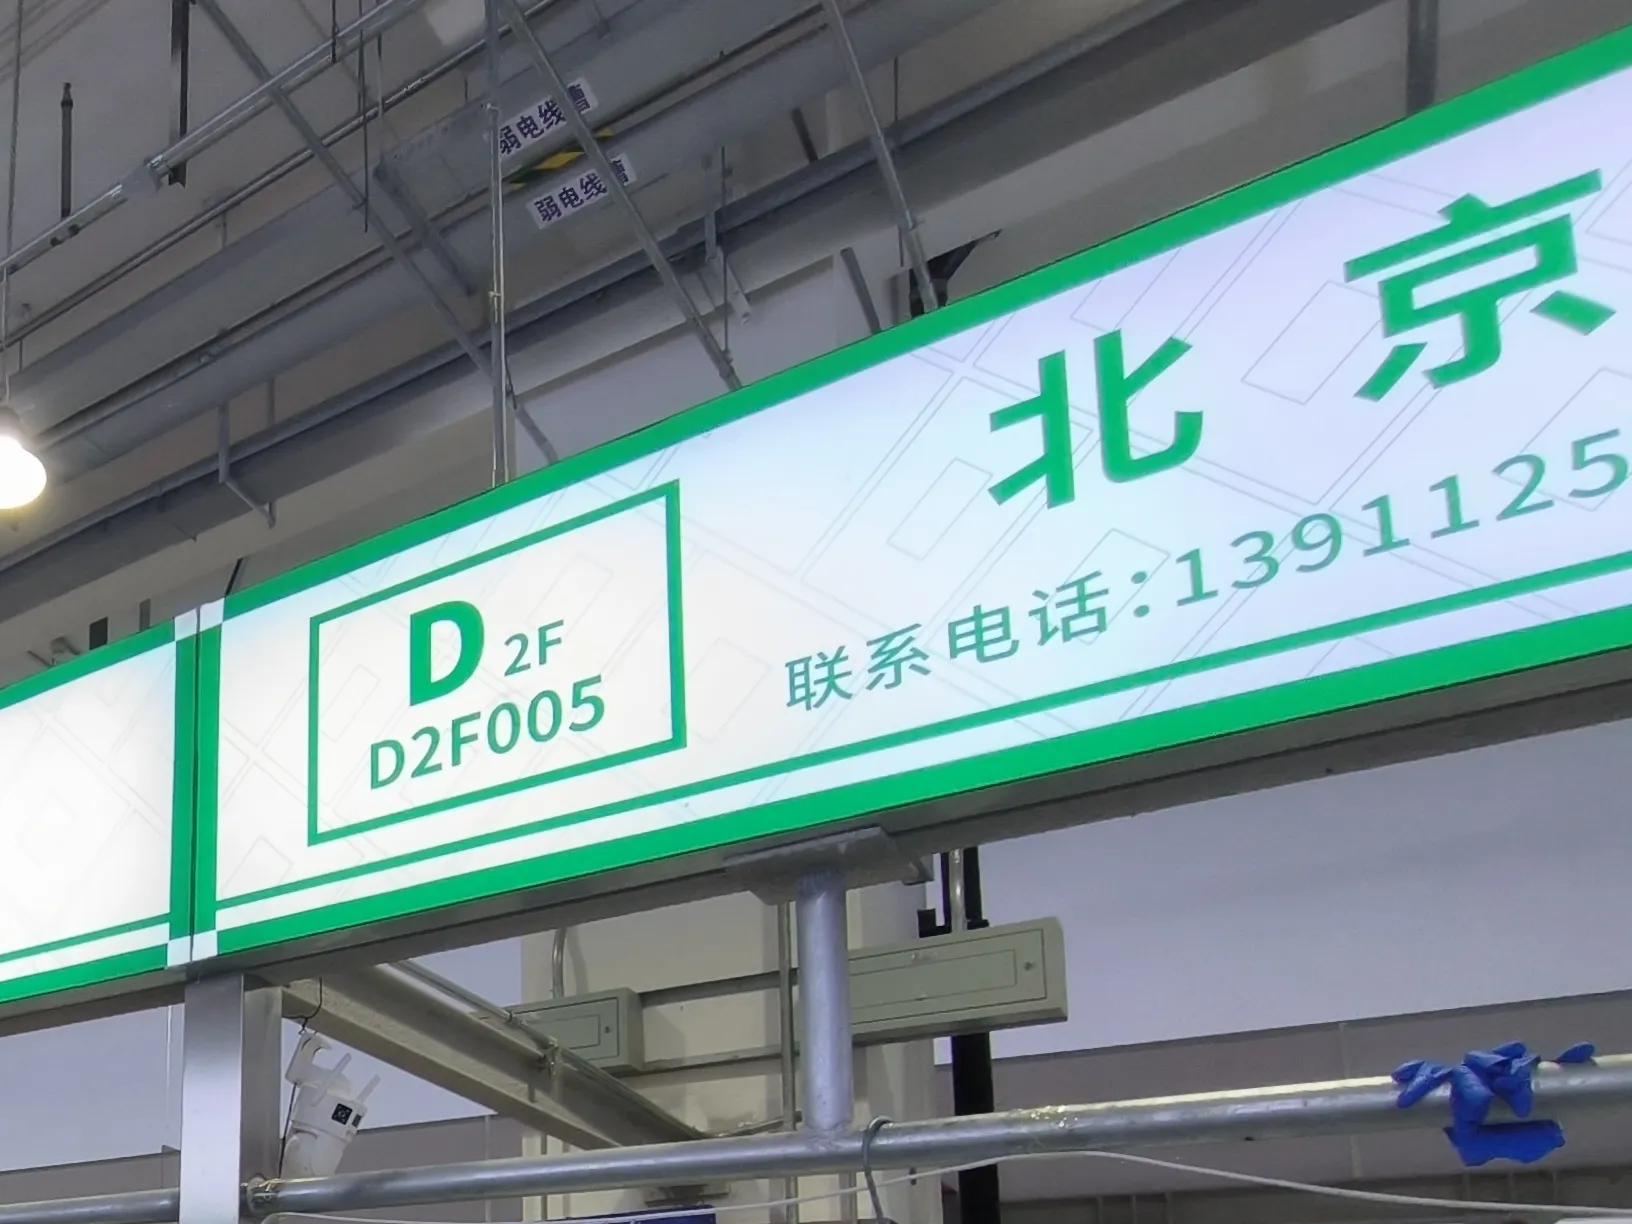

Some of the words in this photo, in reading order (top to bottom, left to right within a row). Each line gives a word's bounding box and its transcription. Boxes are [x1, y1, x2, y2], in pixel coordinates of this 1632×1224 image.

[987, 168, 1617, 510] 北京
[409, 600, 485, 706] D
[503, 619, 565, 678] 2F
[370, 674, 606, 790] D2F005
